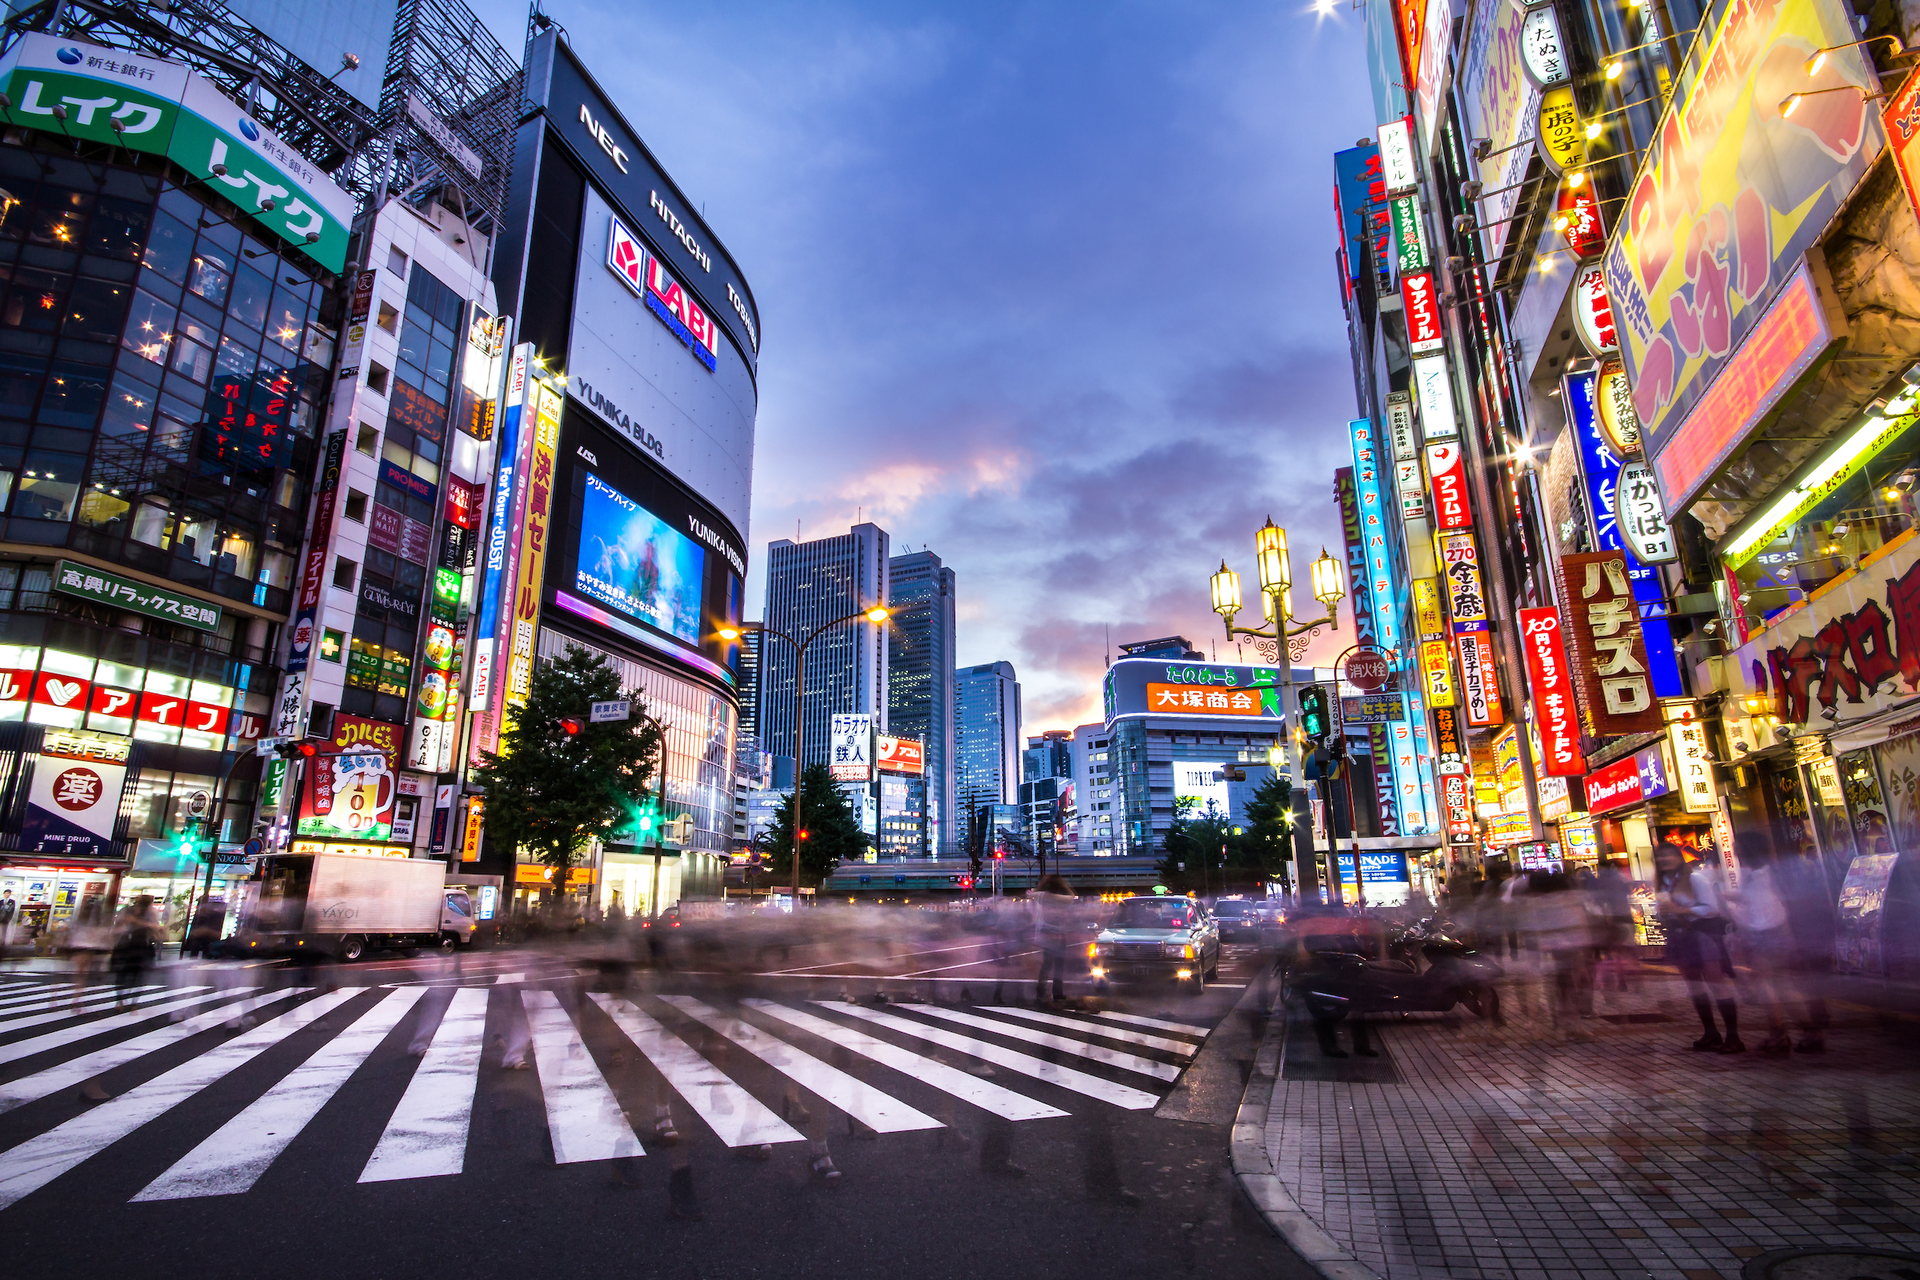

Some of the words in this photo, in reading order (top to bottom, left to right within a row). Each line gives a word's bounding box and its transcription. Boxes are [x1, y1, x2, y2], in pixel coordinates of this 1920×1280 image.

[1534, 27, 1560, 73] たぬき
[86, 54, 155, 81] 新生銀行
[1547, 72, 1562, 83] 5F
[19, 80, 162, 133] レイク
[580, 103, 629, 174] NEC
[1546, 109, 1580, 152] 虎の子
[262, 137, 314, 185] 新生銀行
[1387, 129, 1406, 181] 戸谷ビル
[1564, 154, 1583, 165] 4F
[207, 137, 324, 237] レイク
[650, 189, 711, 273] HITACHI
[1400, 206, 1421, 269] もみの気ハウス
[1568, 227, 1577, 246] 3F
[647, 255, 719, 358] LABI
[727, 282, 757, 353] TOSHIBA
[1411, 289, 1435, 341] アイフル
[515, 366, 524, 391] LABI
[396, 379, 446, 420] 本格台湾式
[405, 400, 433, 425] オイル
[1609, 375, 1639, 443] お好み焼き
[393, 406, 442, 441] マッサージ
[577, 376, 631, 434] YUNIKA
[633, 421, 665, 459] BLDG.
[1870, 414, 1909, 453] お好み焼き
[388, 467, 429, 496] PROMISE
[450, 483, 471, 499] FAST
[499, 466, 512, 485] For
[449, 493, 470, 509] NAIL
[496, 484, 510, 518] Your
[1439, 474, 1461, 515] アコム
[1631, 479, 1667, 537] かっぱ
[376, 521, 395, 534] NAIL
[377, 512, 397, 525] FAST
[518, 448, 552, 620] 決算セール
[1446, 515, 1462, 526] 3F
[487, 525, 506, 571] JUST
[688, 514, 725, 556] YUNIKA
[726, 543, 745, 578] VISION
[1446, 547, 1475, 562] 270
[1644, 541, 1669, 555] B1
[303, 551, 323, 606] アイフル
[1449, 560, 1484, 618] 金の蔵
[1629, 569, 1651, 579] 3F
[1348, 544, 1375, 640] エスパス
[294, 627, 312, 644] 薬
[1464, 622, 1480, 632] 2F
[1581, 558, 1652, 716] パチスロ
[1425, 643, 1449, 695] 麻雀ブル
[1525, 617, 1560, 689] 100円ショップ
[478, 667, 488, 696] LABI
[1166, 665, 1238, 687] たのめーる
[1348, 661, 1387, 679] 消火栓
[1460, 637, 1487, 721] 東京チカラめし
[1481, 663, 1496, 704] 焼き牛丼
[101, 688, 260, 739] アイフル
[278, 677, 302, 735] 大勝軒
[594, 702, 628, 715] 歌舞伎町
[1156, 689, 1253, 710] 大塚商会
[1344, 700, 1360, 715] 質
[1361, 701, 1403, 715] セキネ
[1365, 695, 1401, 703] 3352-7325
[1436, 695, 1448, 704] 6F
[833, 717, 870, 736] カラオケ
[846, 734, 855, 747] の
[1436, 708, 1458, 754] お好み焼
[56, 740, 127, 762] ミネドラッグ
[835, 746, 864, 763] 鉄人
[898, 746, 920, 759] アコム
[1445, 763, 1460, 772] 8F
[1681, 727, 1710, 796] 養老乃瀧
[56, 772, 100, 805] 薬
[270, 763, 284, 799] レイク
[400, 782, 417, 793] 修理
[1376, 771, 1400, 837] エスパス
[1446, 777, 1468, 822] 居酒屋
[44, 833, 64, 843] MINE
[67, 834, 91, 843] DRUG
[1455, 833, 1469, 843] 4F
[205, 853, 246, 864] PNDORA
[1337, 855, 1398, 866] SUNADE
